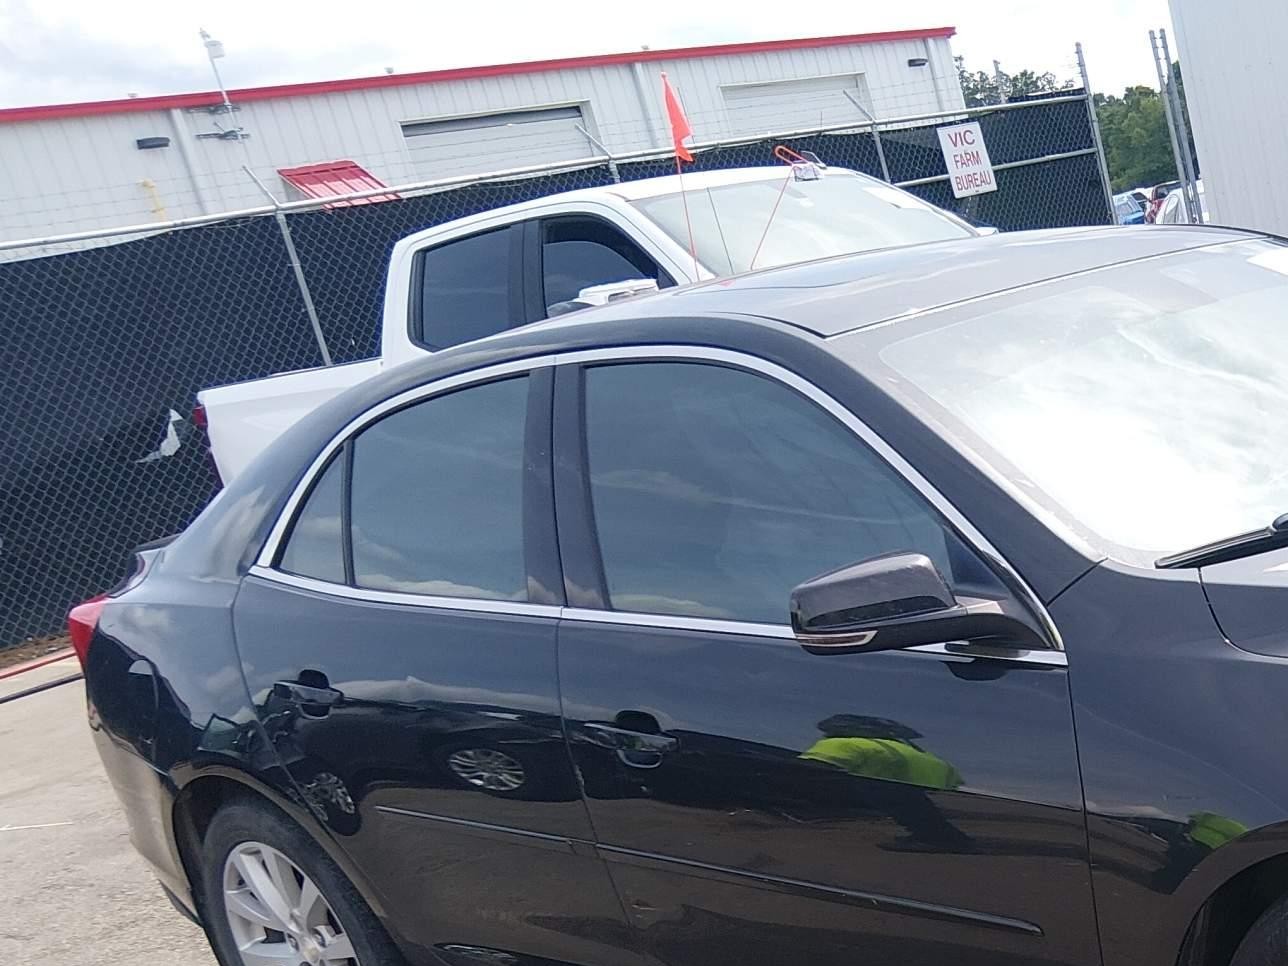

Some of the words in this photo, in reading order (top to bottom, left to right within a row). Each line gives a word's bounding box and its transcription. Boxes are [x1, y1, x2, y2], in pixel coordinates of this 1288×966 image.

[948, 130, 975, 148] VIC
[953, 151, 982, 169] FARM
[955, 170, 992, 191] BUREAU
